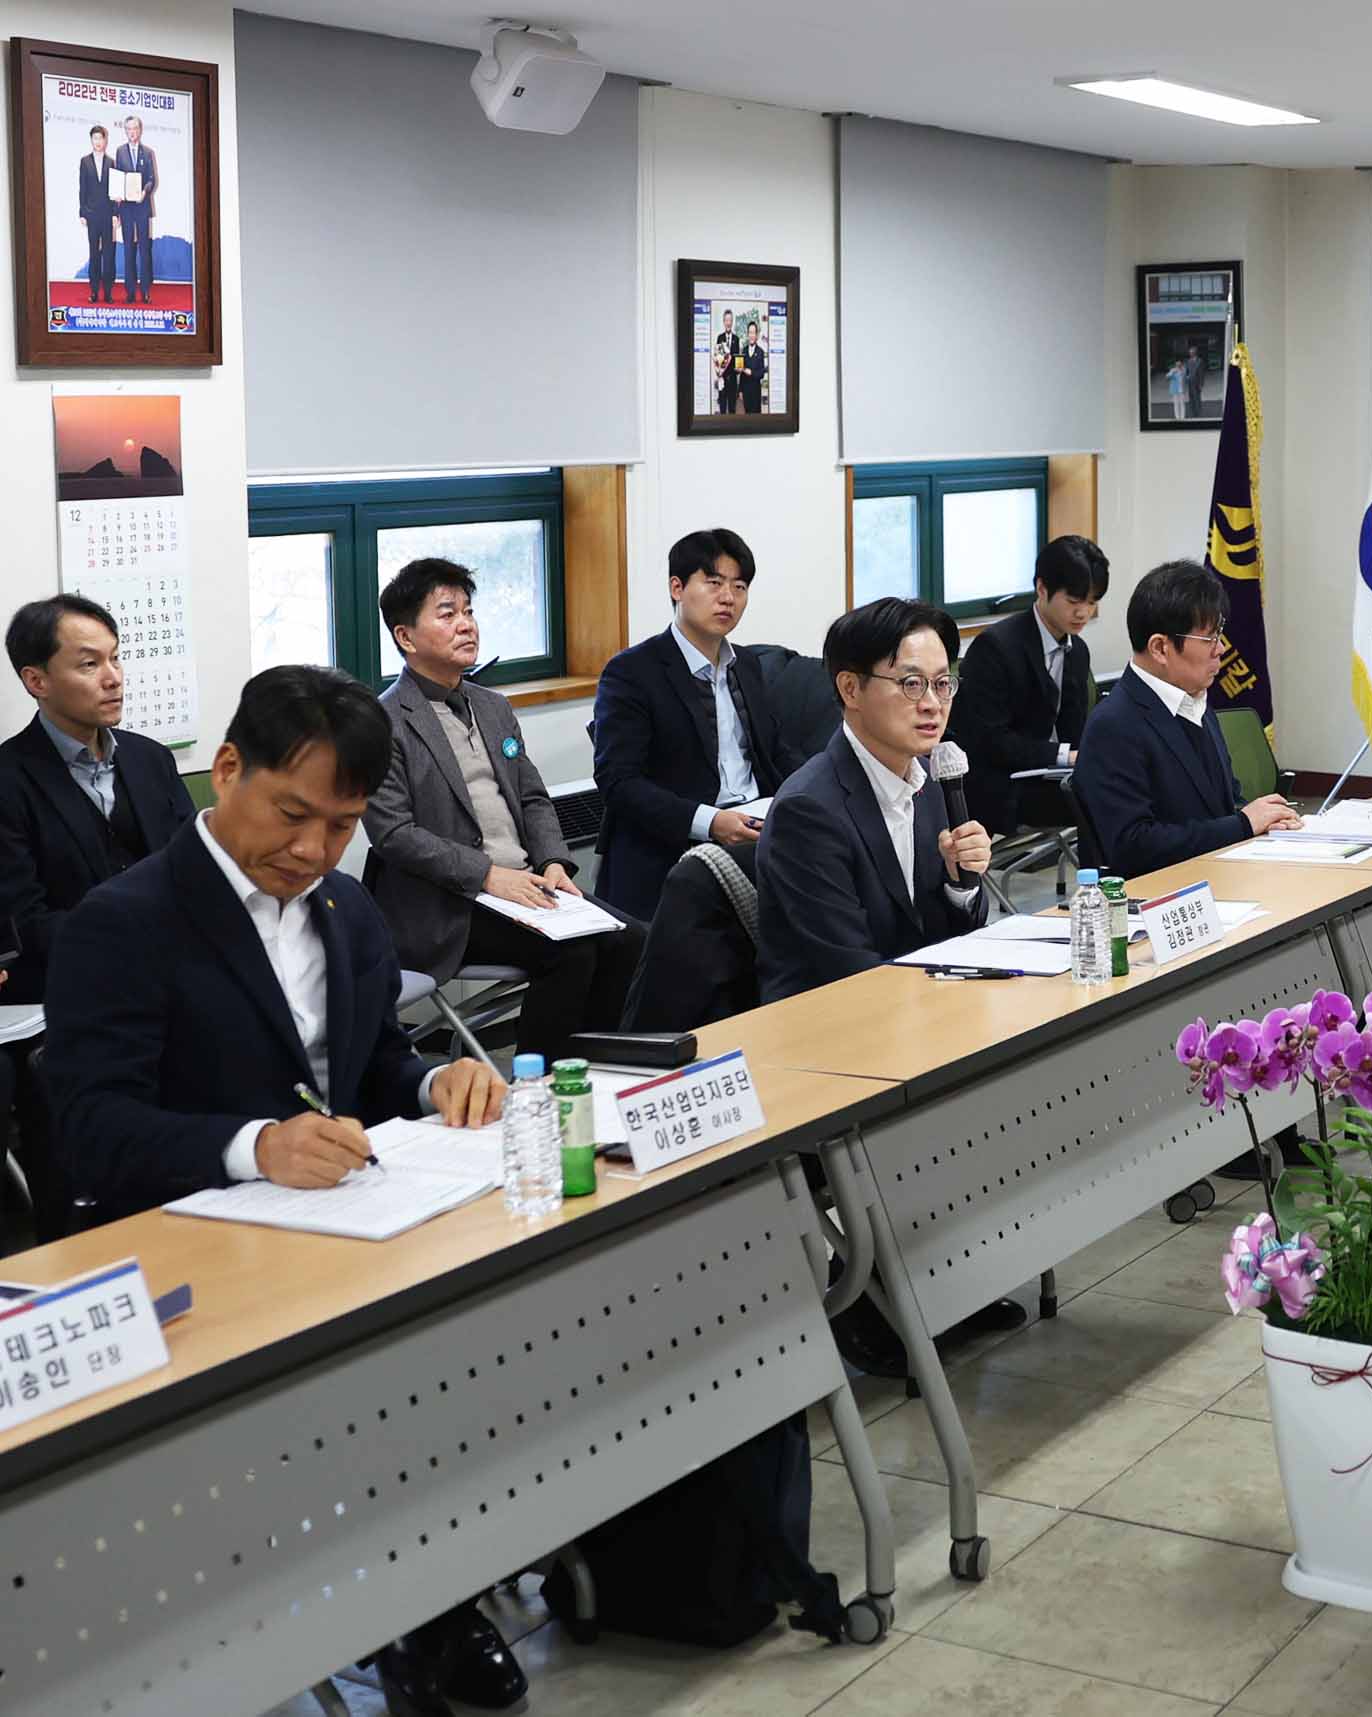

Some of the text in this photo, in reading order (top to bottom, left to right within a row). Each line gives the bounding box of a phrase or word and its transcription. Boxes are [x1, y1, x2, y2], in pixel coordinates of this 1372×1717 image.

[58, 81, 175, 110] 2022년 전북 중소기업인대회
[70, 509, 81, 521] 12
[160, 581, 165, 590] 2
[106, 602, 111, 611] 5
[120, 601, 125, 610] 6
[134, 600, 139, 608] 7
[148, 598, 152, 607] 8
[161, 597, 166, 606] 9
[120, 617, 128, 626] 13
[134, 616, 143, 624] 14
[147, 614, 156, 624] 15
[161, 613, 170, 622] 16
[121, 634, 130, 644] 20
[135, 632, 143, 642] 21
[148, 631, 157, 640] 22
[162, 629, 171, 639] 23
[122, 650, 131, 660] 27
[136, 649, 145, 659] 28
[150, 647, 159, 657] 29
[163, 646, 172, 655] 30
[1161, 899, 1204, 930] 산업통상부
[1166, 925, 1194, 950] 김정관
[626, 1069, 750, 1132] 한국산업단지공단
[654, 1106, 742, 1150] 이상훈 이사장
[4, 1293, 137, 1363] 테크노파크
